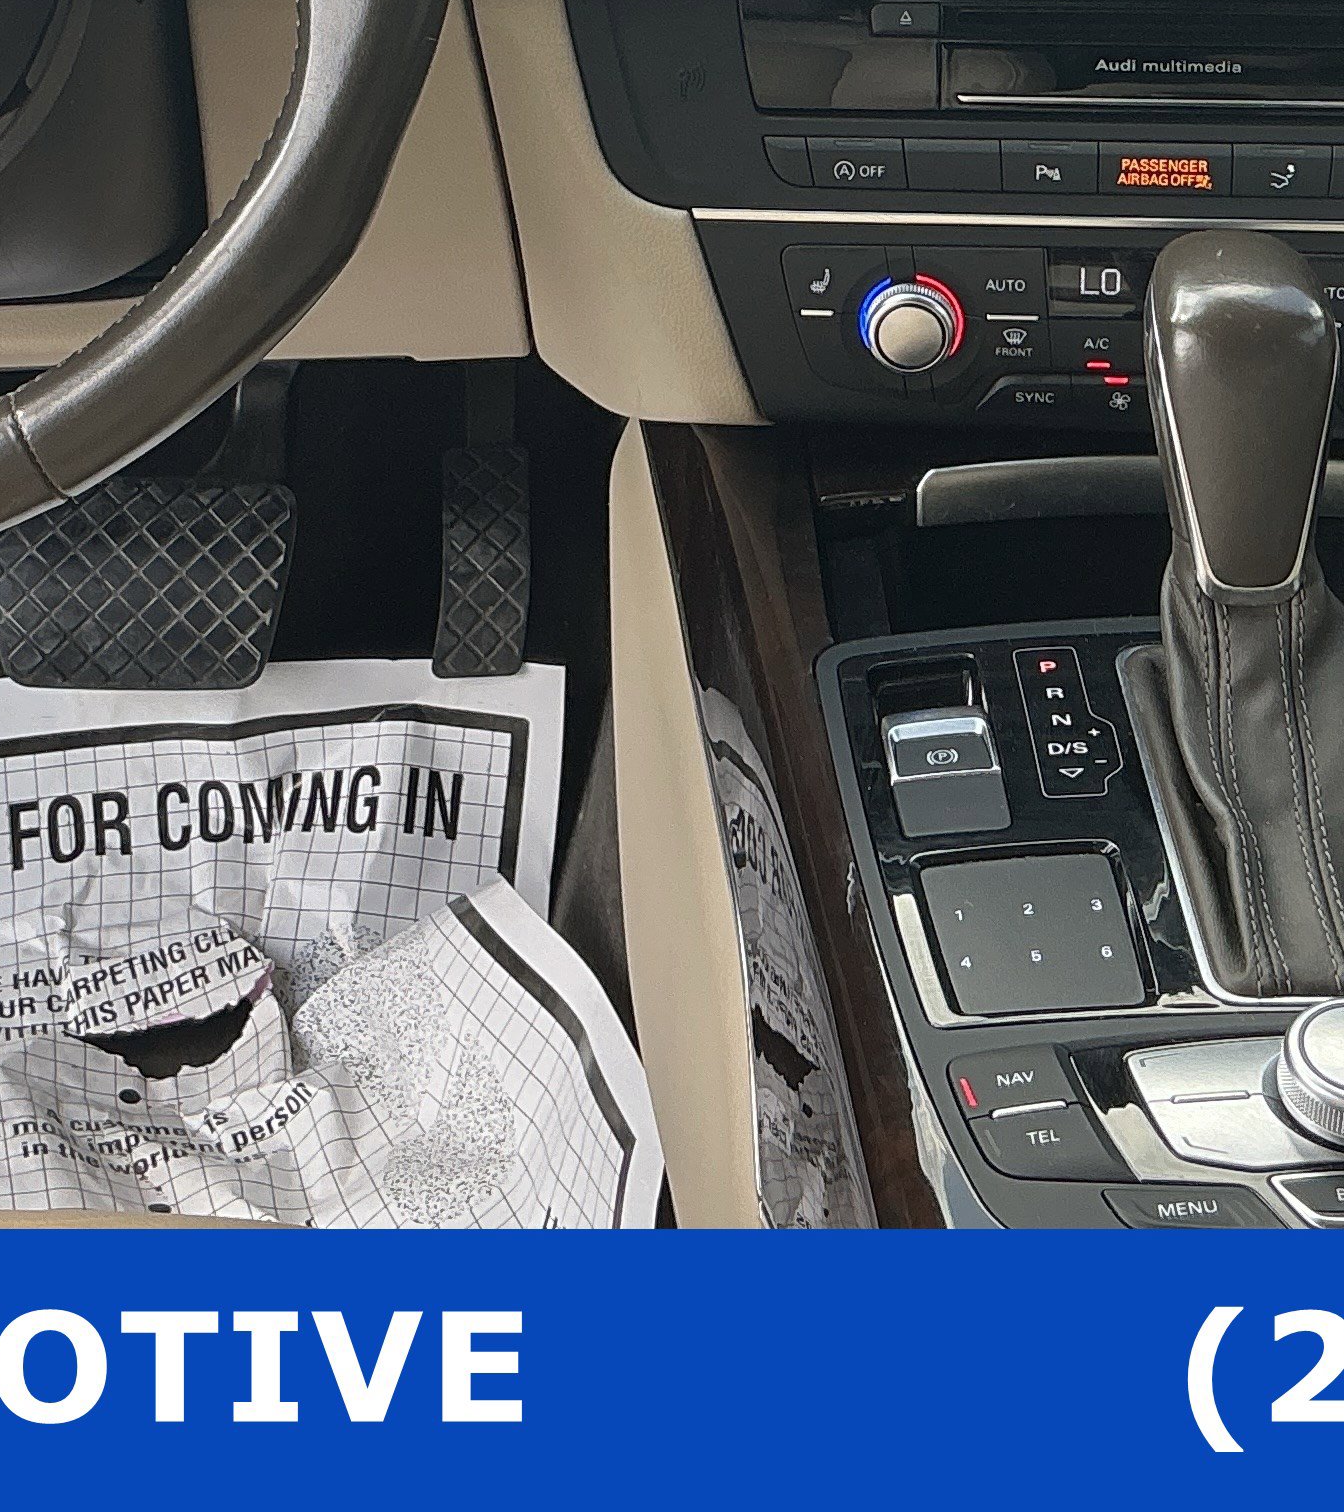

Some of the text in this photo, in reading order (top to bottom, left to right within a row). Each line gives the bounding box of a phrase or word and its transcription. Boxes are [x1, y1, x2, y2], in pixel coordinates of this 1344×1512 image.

[1094, 58, 1243, 73] Audi multimedia
[859, 164, 887, 179] OFF
[1121, 158, 1208, 172] PASSENGER
[1117, 172, 1195, 186] AIRBAG OFF
[985, 279, 1026, 293] AUTO
[1079, 267, 1122, 296] LO
[995, 347, 1034, 357] FRONT
[1083, 337, 1110, 351] A/C
[1015, 391, 1055, 404] SYNC
[1039, 660, 1057, 674] P
[1046, 687, 1064, 699] R
[1051, 713, 1072, 726] N
[1047, 741, 1089, 755] D/S
[8, 791, 132, 871] FOR
[156, 764, 381, 852] COMING
[403, 767, 464, 841] IN
[954, 898, 1103, 921] 1 2 3
[960, 945, 1113, 969] 4 5 6
[47, 941, 187, 1013] CARPETING
[58, 1003, 117, 1035] THIS
[124, 967, 211, 1016] PAPER
[217, 945, 260, 979] MA
[996, 1070, 1035, 1087] NAV
[12, 1120, 56, 1135] mo
[231, 1081, 314, 1152] person
[203, 1107, 229, 1133] is
[1026, 1128, 1061, 1146] TEL
[21, 1140, 49, 1159] in
[58, 1141, 102, 1169] the
[1158, 1199, 1219, 1218] MENU
